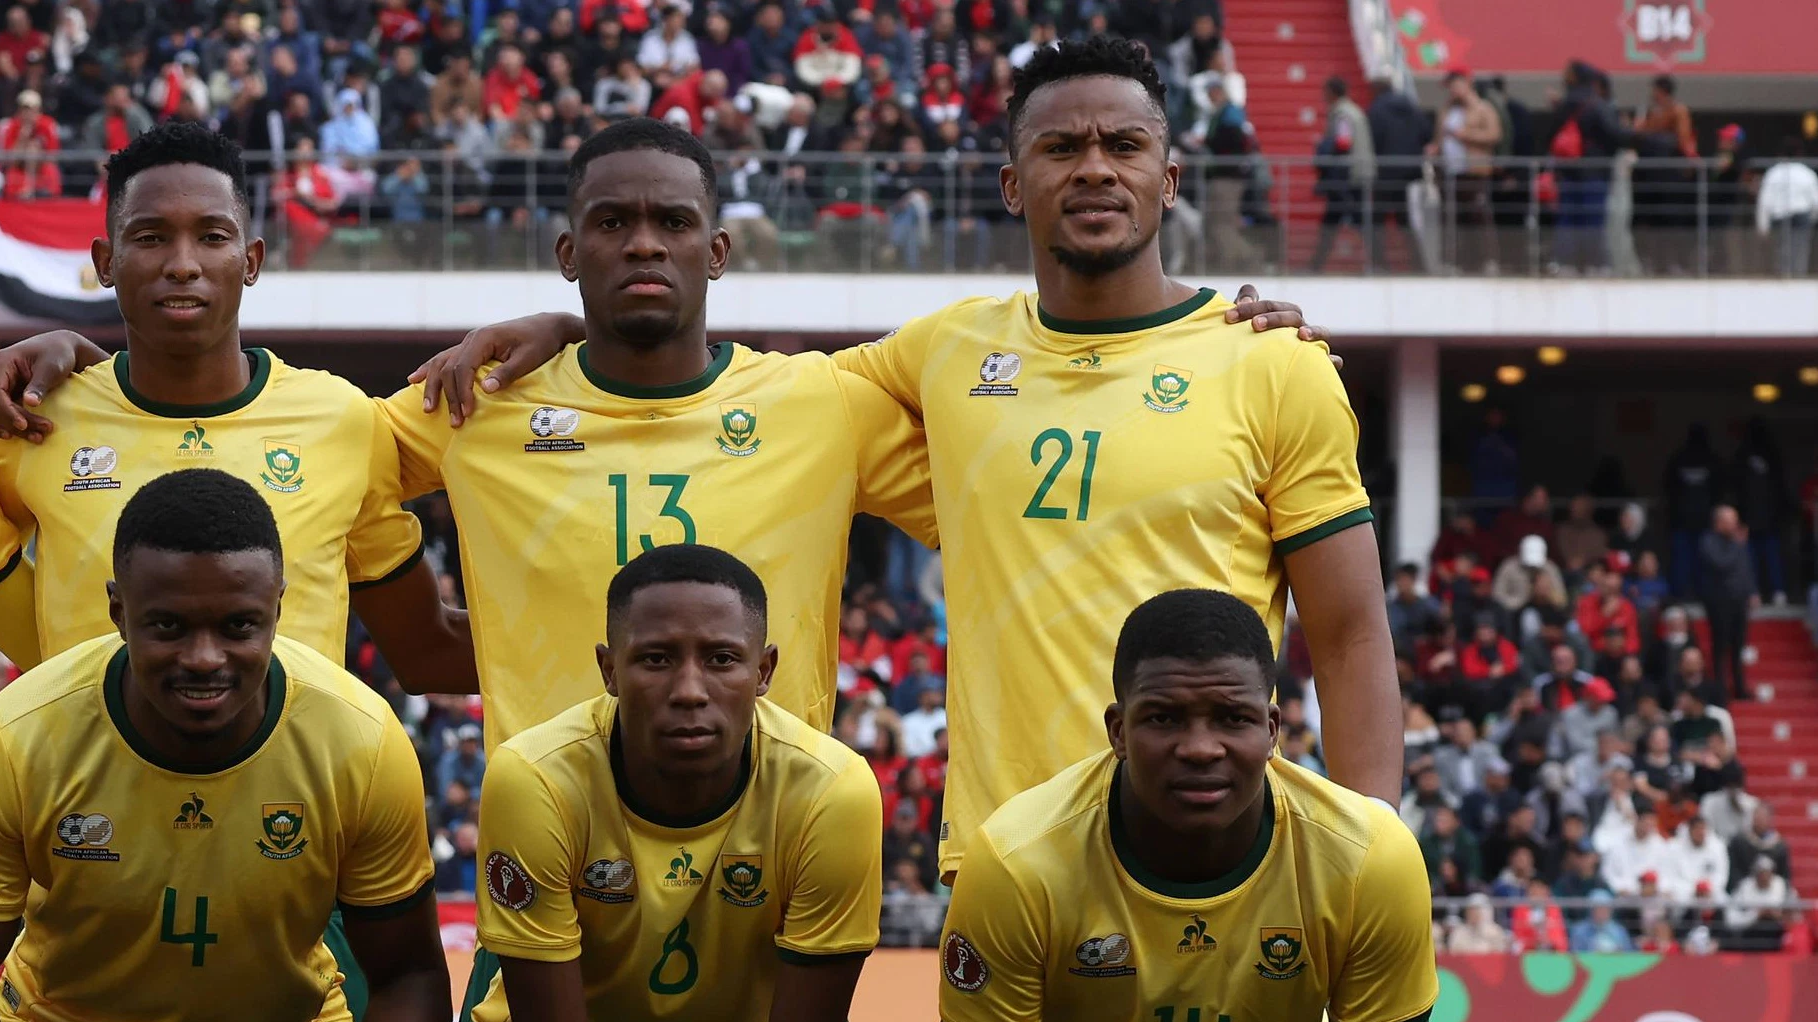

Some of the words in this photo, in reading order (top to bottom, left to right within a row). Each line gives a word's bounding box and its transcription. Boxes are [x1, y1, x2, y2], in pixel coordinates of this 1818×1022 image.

[1637, 3, 1693, 43] B14
[1022, 428, 1102, 521] 21
[508, 861, 528, 881] AFRICA
[160, 886, 218, 967] 4
